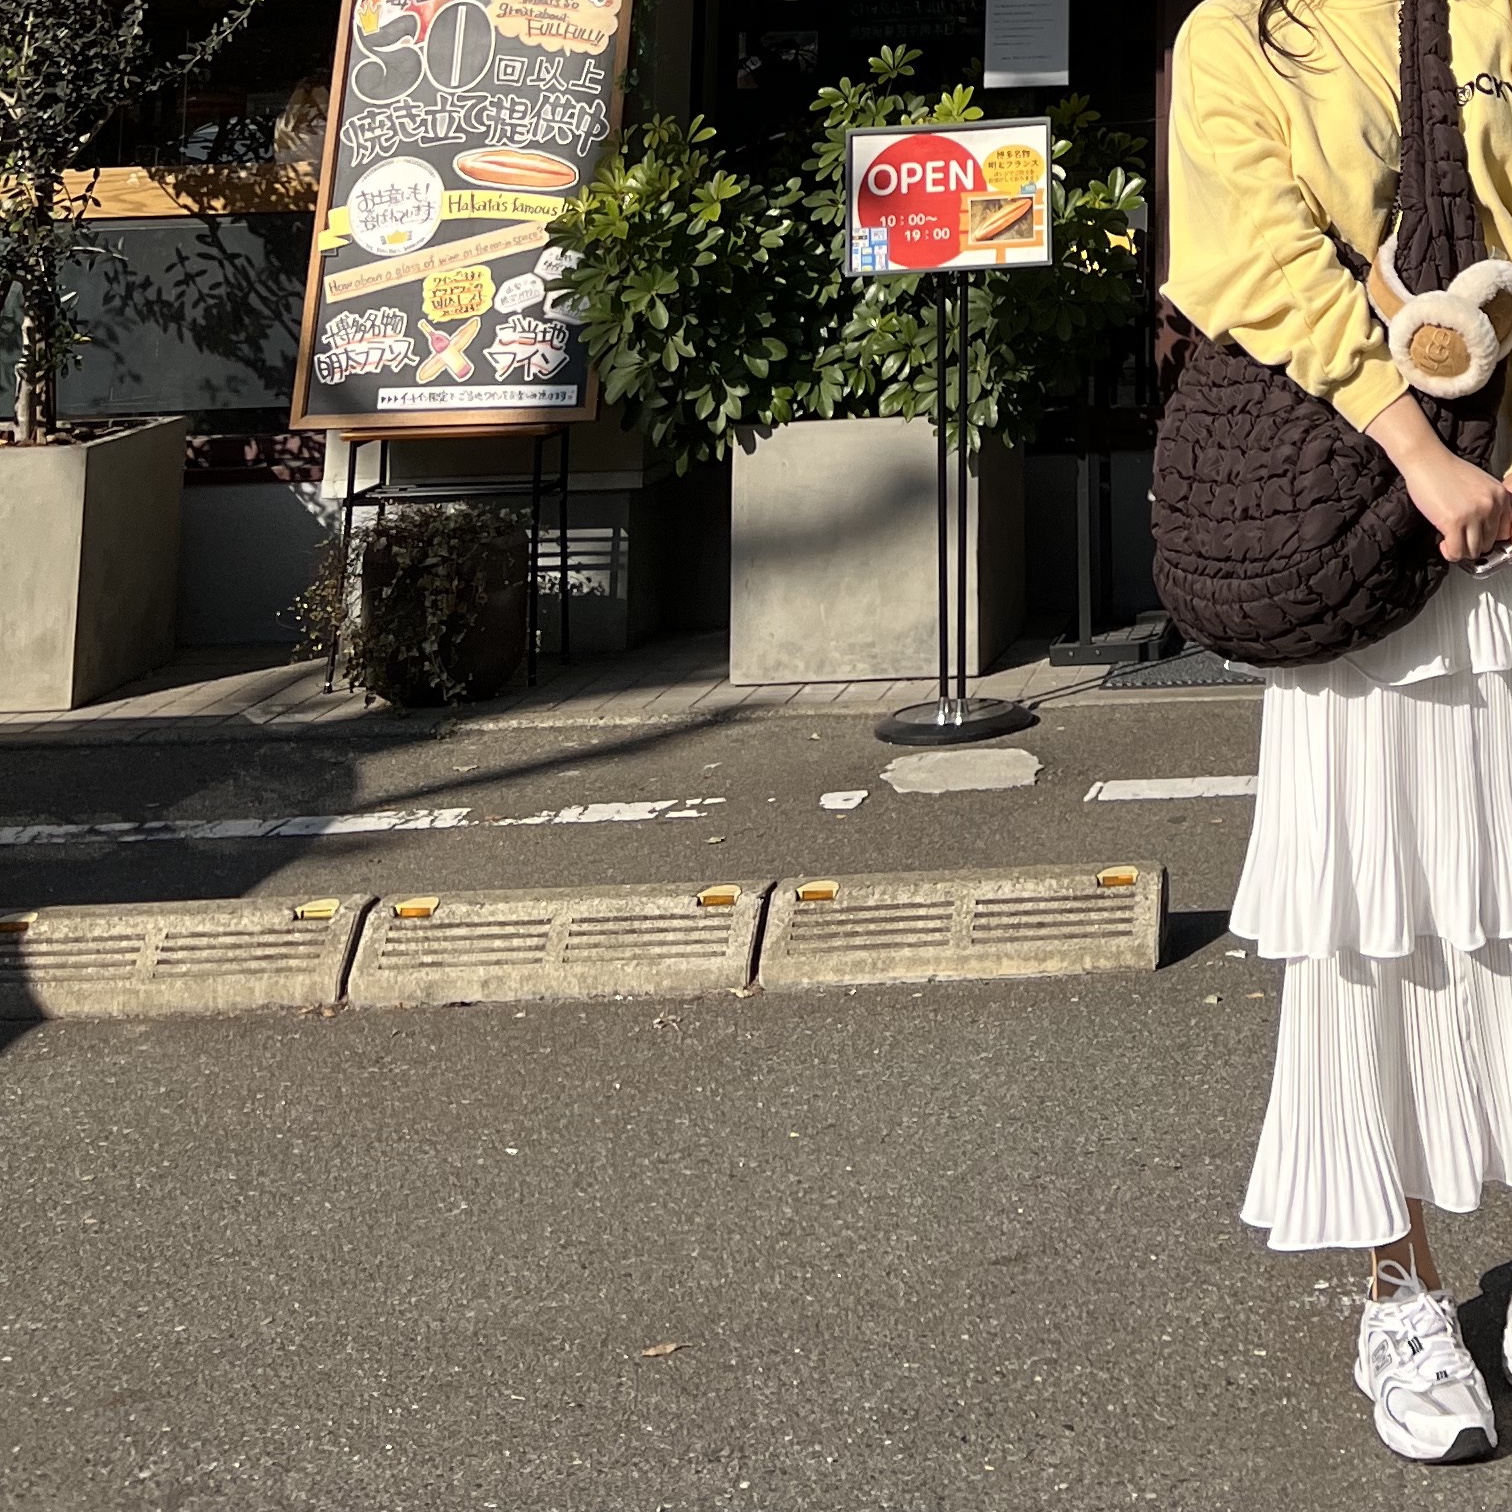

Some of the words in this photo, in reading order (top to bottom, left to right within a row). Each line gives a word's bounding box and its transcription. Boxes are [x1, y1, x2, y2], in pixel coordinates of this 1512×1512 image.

[526, 18, 563, 38] FULL
[340, 92, 610, 167] 焼き立て提供中
[868, 159, 974, 197] OPEN
[449, 191, 508, 213] Hakata's
[328, 279, 352, 294] How
[325, 310, 404, 348] 博多名物
[499, 317, 564, 350] ご当地
[317, 340, 416, 381] 明太フランス
[487, 349, 567, 378] ワイン
